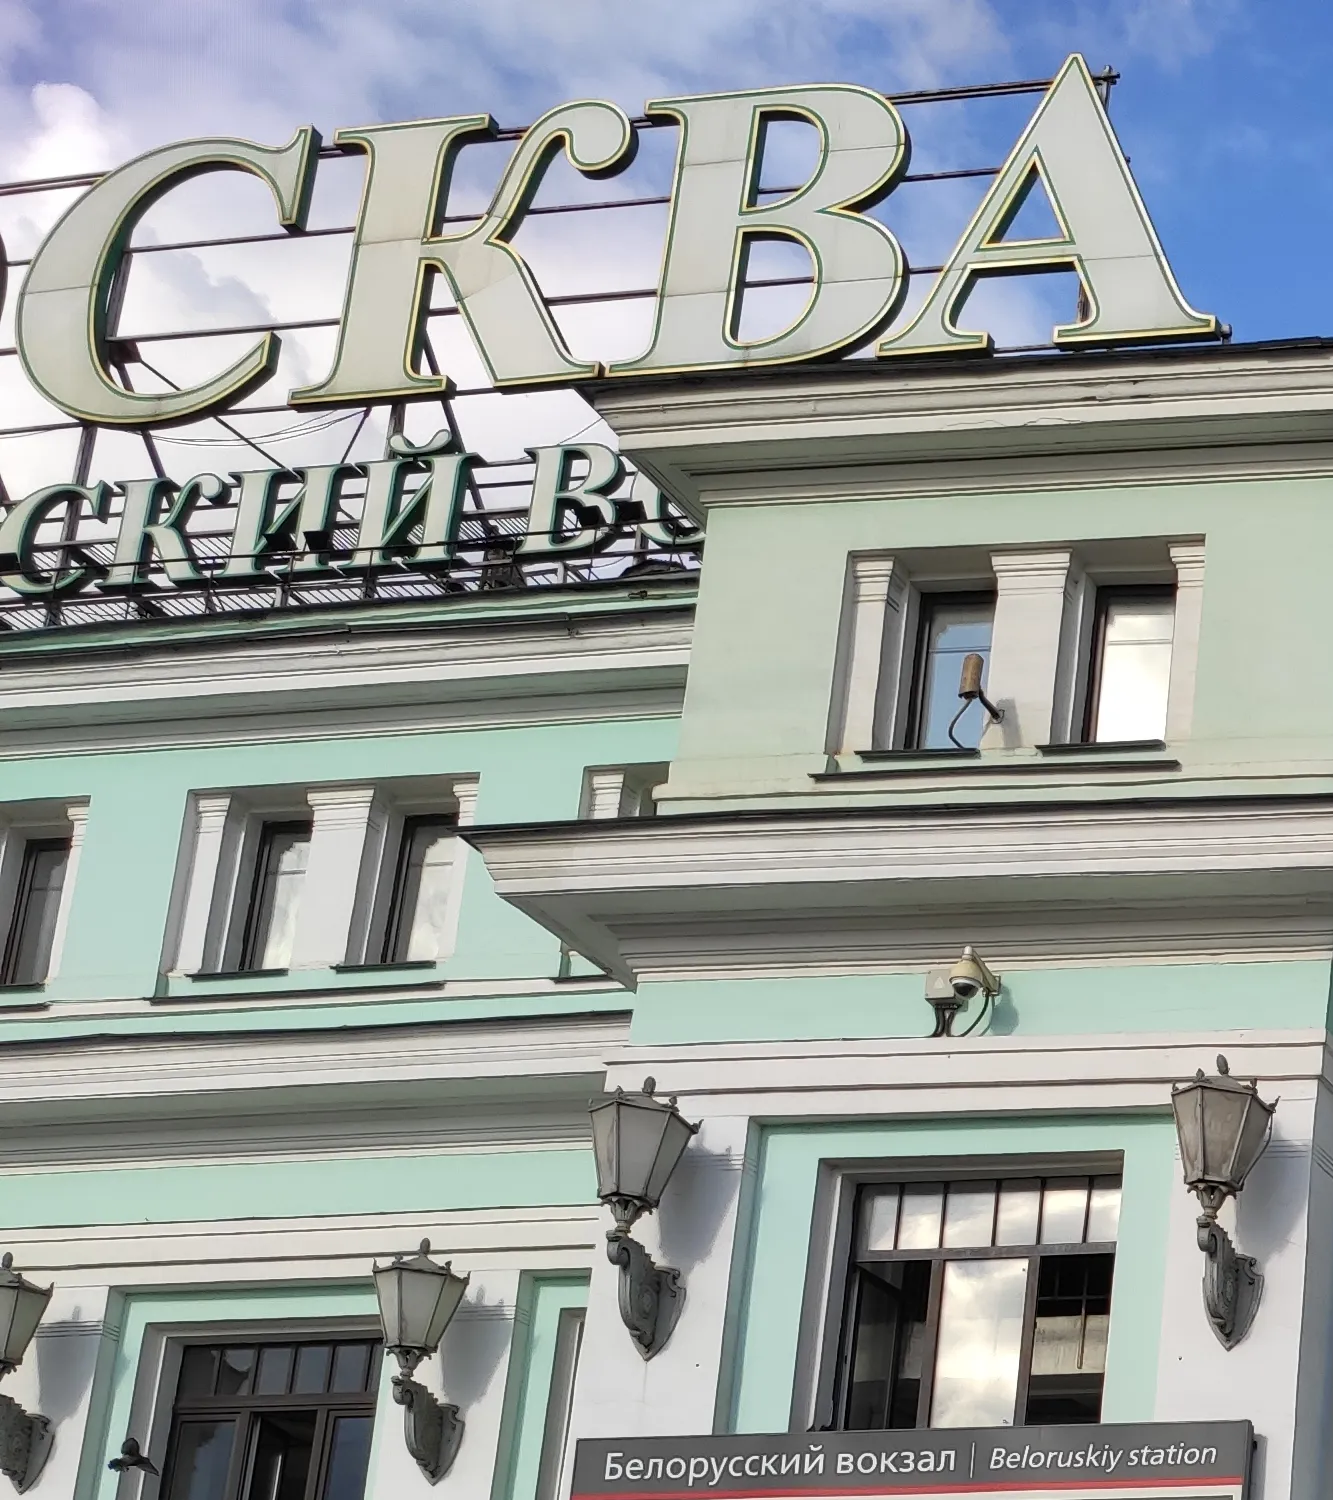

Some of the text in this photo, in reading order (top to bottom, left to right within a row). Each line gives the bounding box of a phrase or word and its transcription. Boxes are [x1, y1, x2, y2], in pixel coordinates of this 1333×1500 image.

[0, 52, 1219, 426] СКВА
[604, 1444, 956, 1487] Белорусский вокзал
[989, 1443, 1218, 1474] Beloruskiy station
